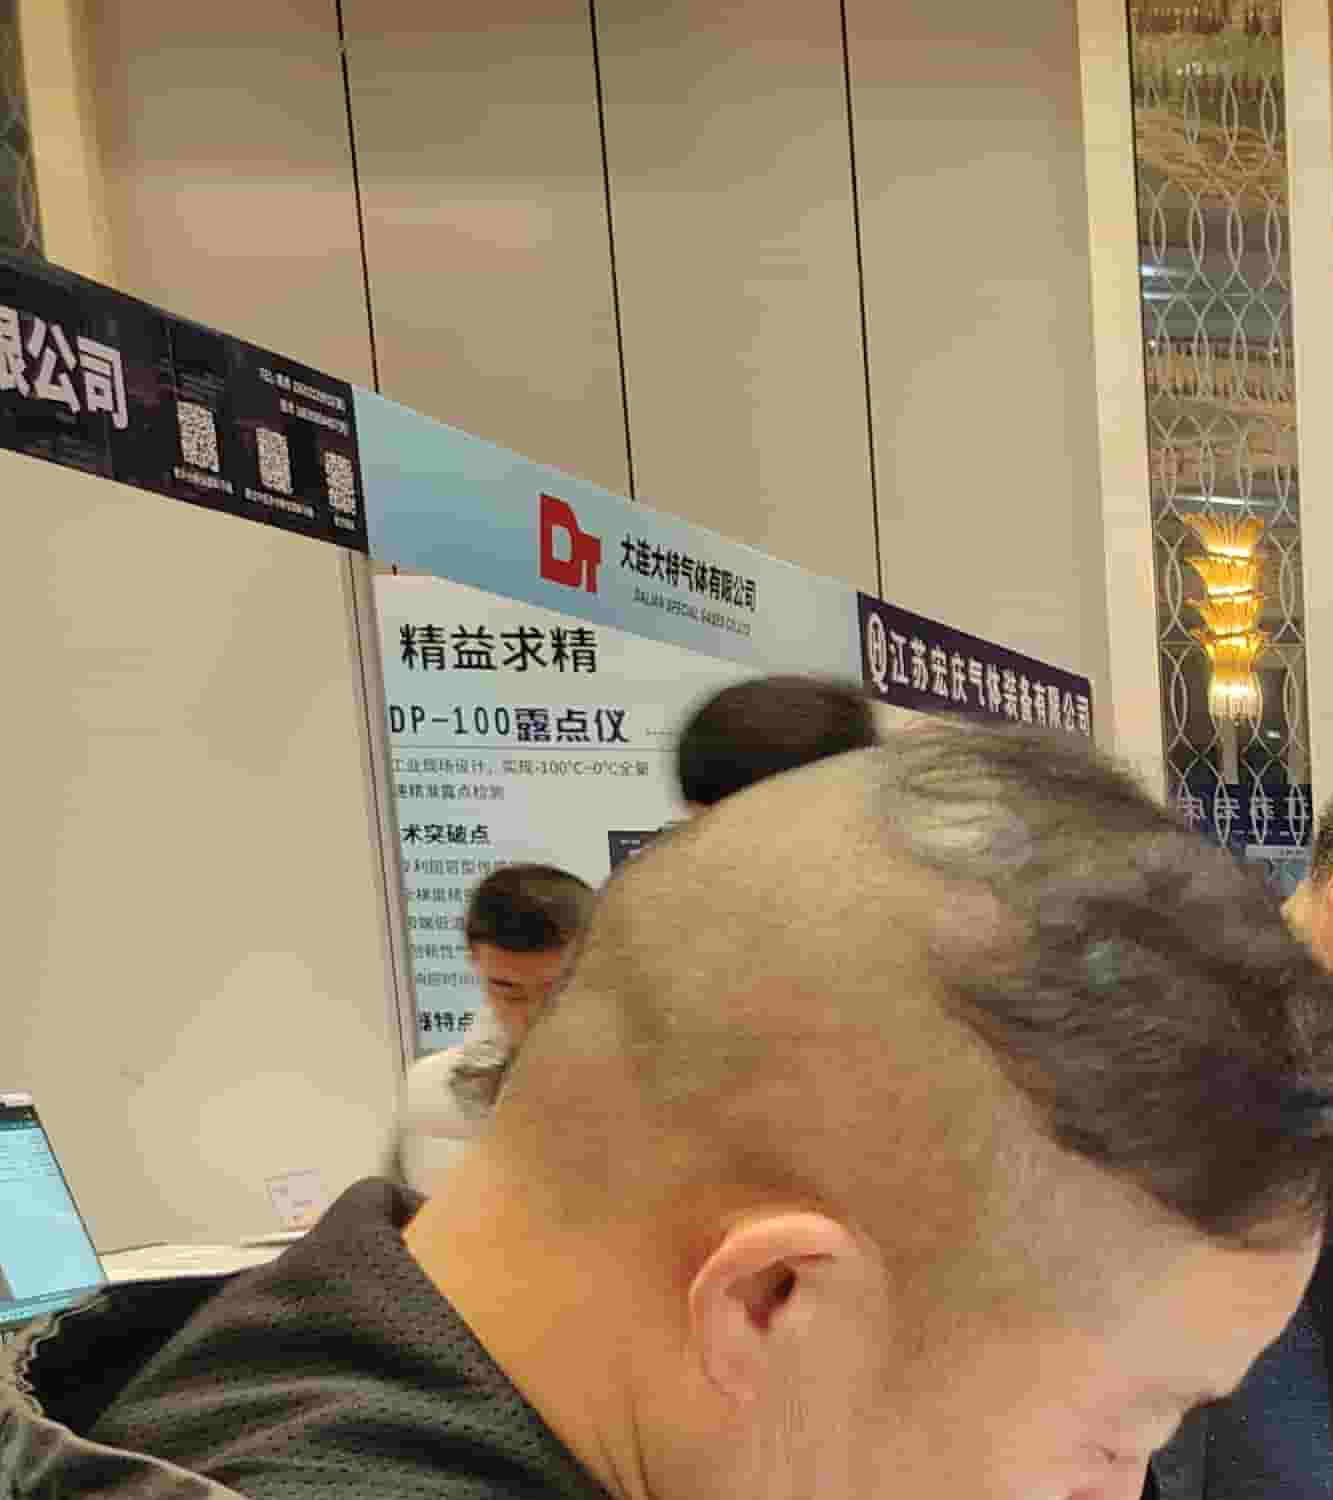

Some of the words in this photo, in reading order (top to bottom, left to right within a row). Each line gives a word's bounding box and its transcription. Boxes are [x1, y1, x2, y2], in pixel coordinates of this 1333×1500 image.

[619, 533, 758, 613] 大连大特气体有限公司
[399, 623, 599, 674] 精益求精
[388, 704, 630, 744] DP-100露点仪
